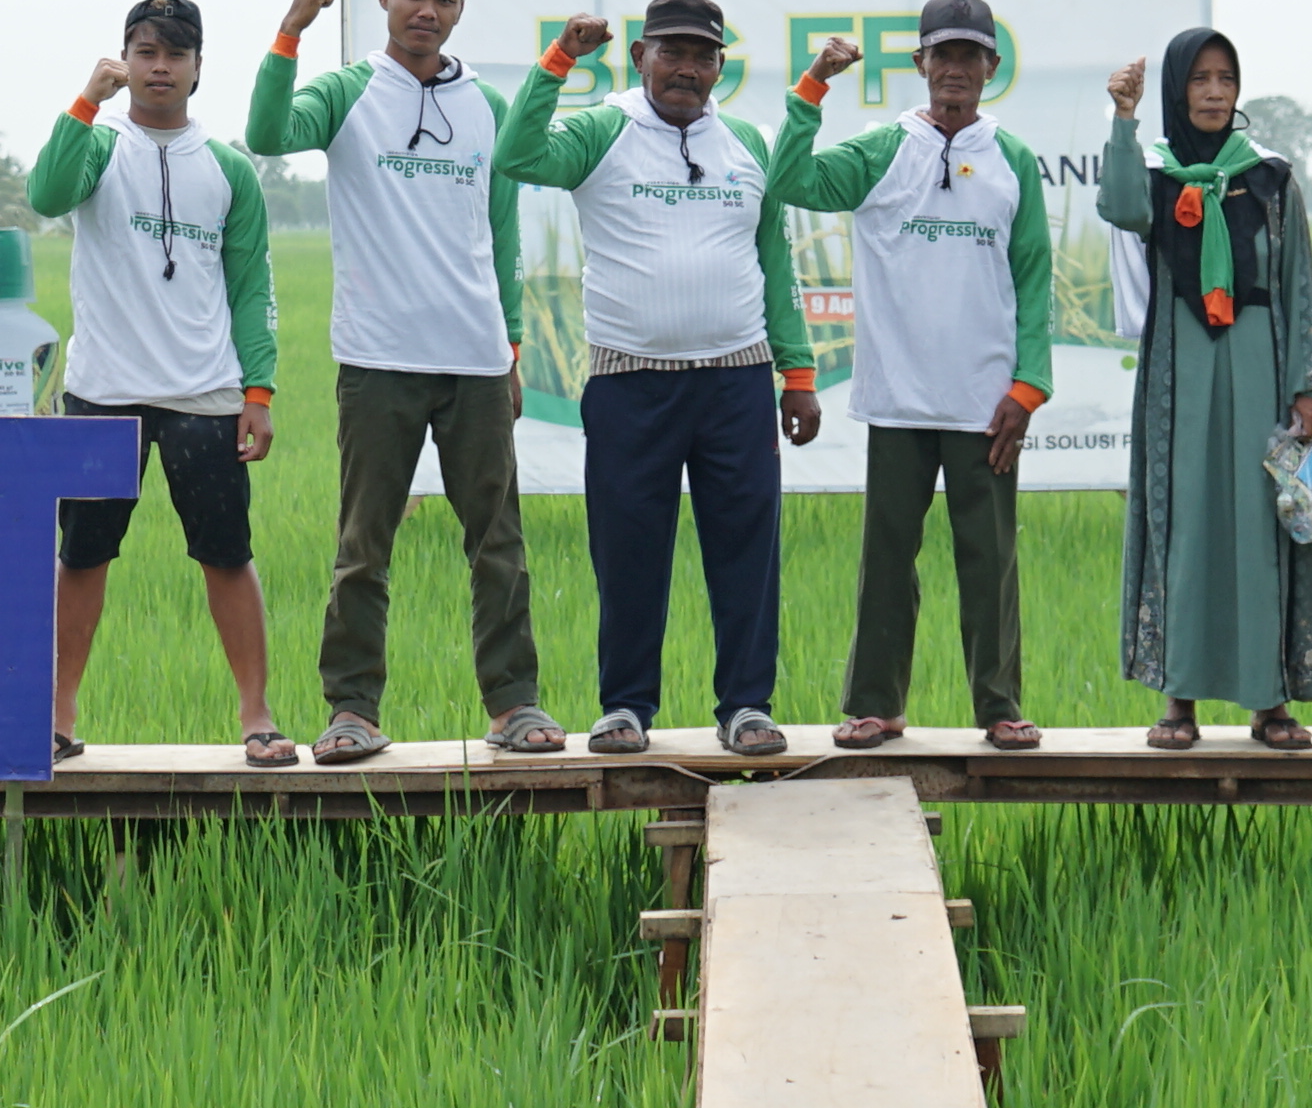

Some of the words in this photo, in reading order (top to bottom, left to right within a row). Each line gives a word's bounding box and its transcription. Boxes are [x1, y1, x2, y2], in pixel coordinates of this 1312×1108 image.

[377, 154, 475, 178] Progressive
[632, 184, 743, 205] Progressive
[130, 216, 218, 243] rogressive
[899, 221, 996, 242] Progressive
[1046, 434, 1116, 450] SOLUSI
